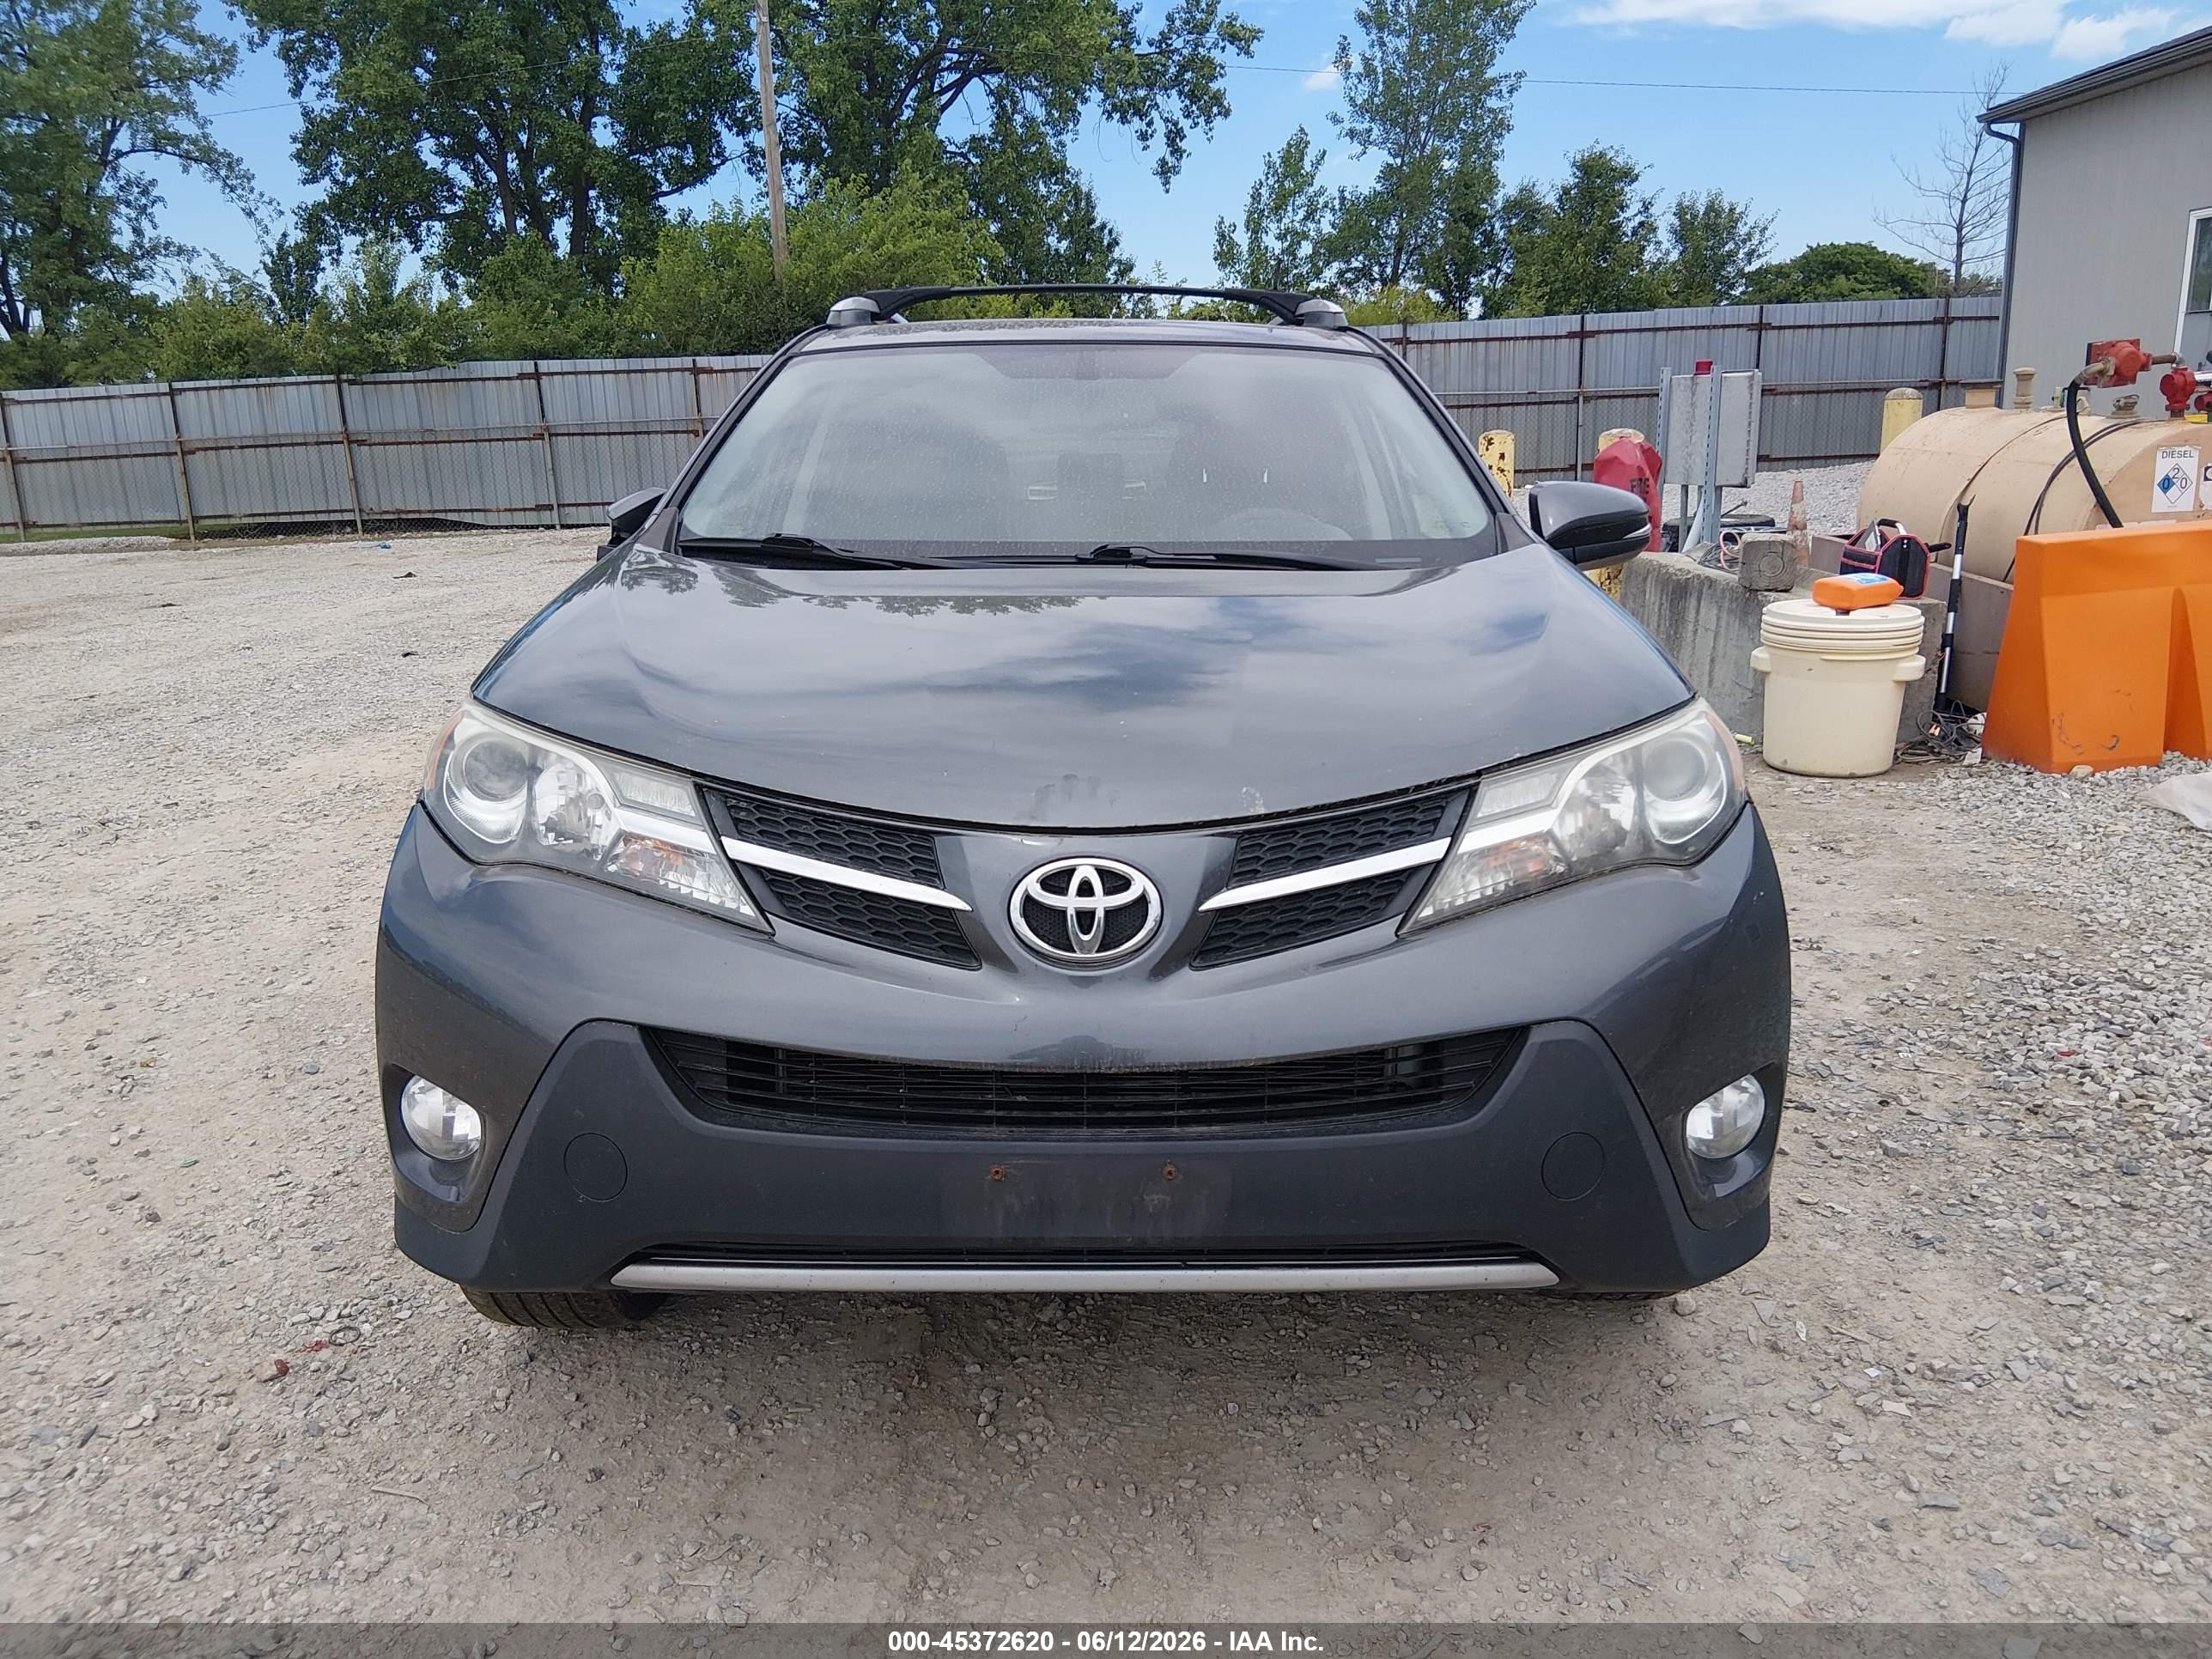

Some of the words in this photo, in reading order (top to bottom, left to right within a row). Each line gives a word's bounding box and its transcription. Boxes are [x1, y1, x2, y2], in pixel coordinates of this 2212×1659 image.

[2161, 449, 2194, 459] DIESEL
[2172, 467, 2180, 479] 2
[2162, 477, 2170, 490] 0
[2179, 477, 2188, 489] 0
